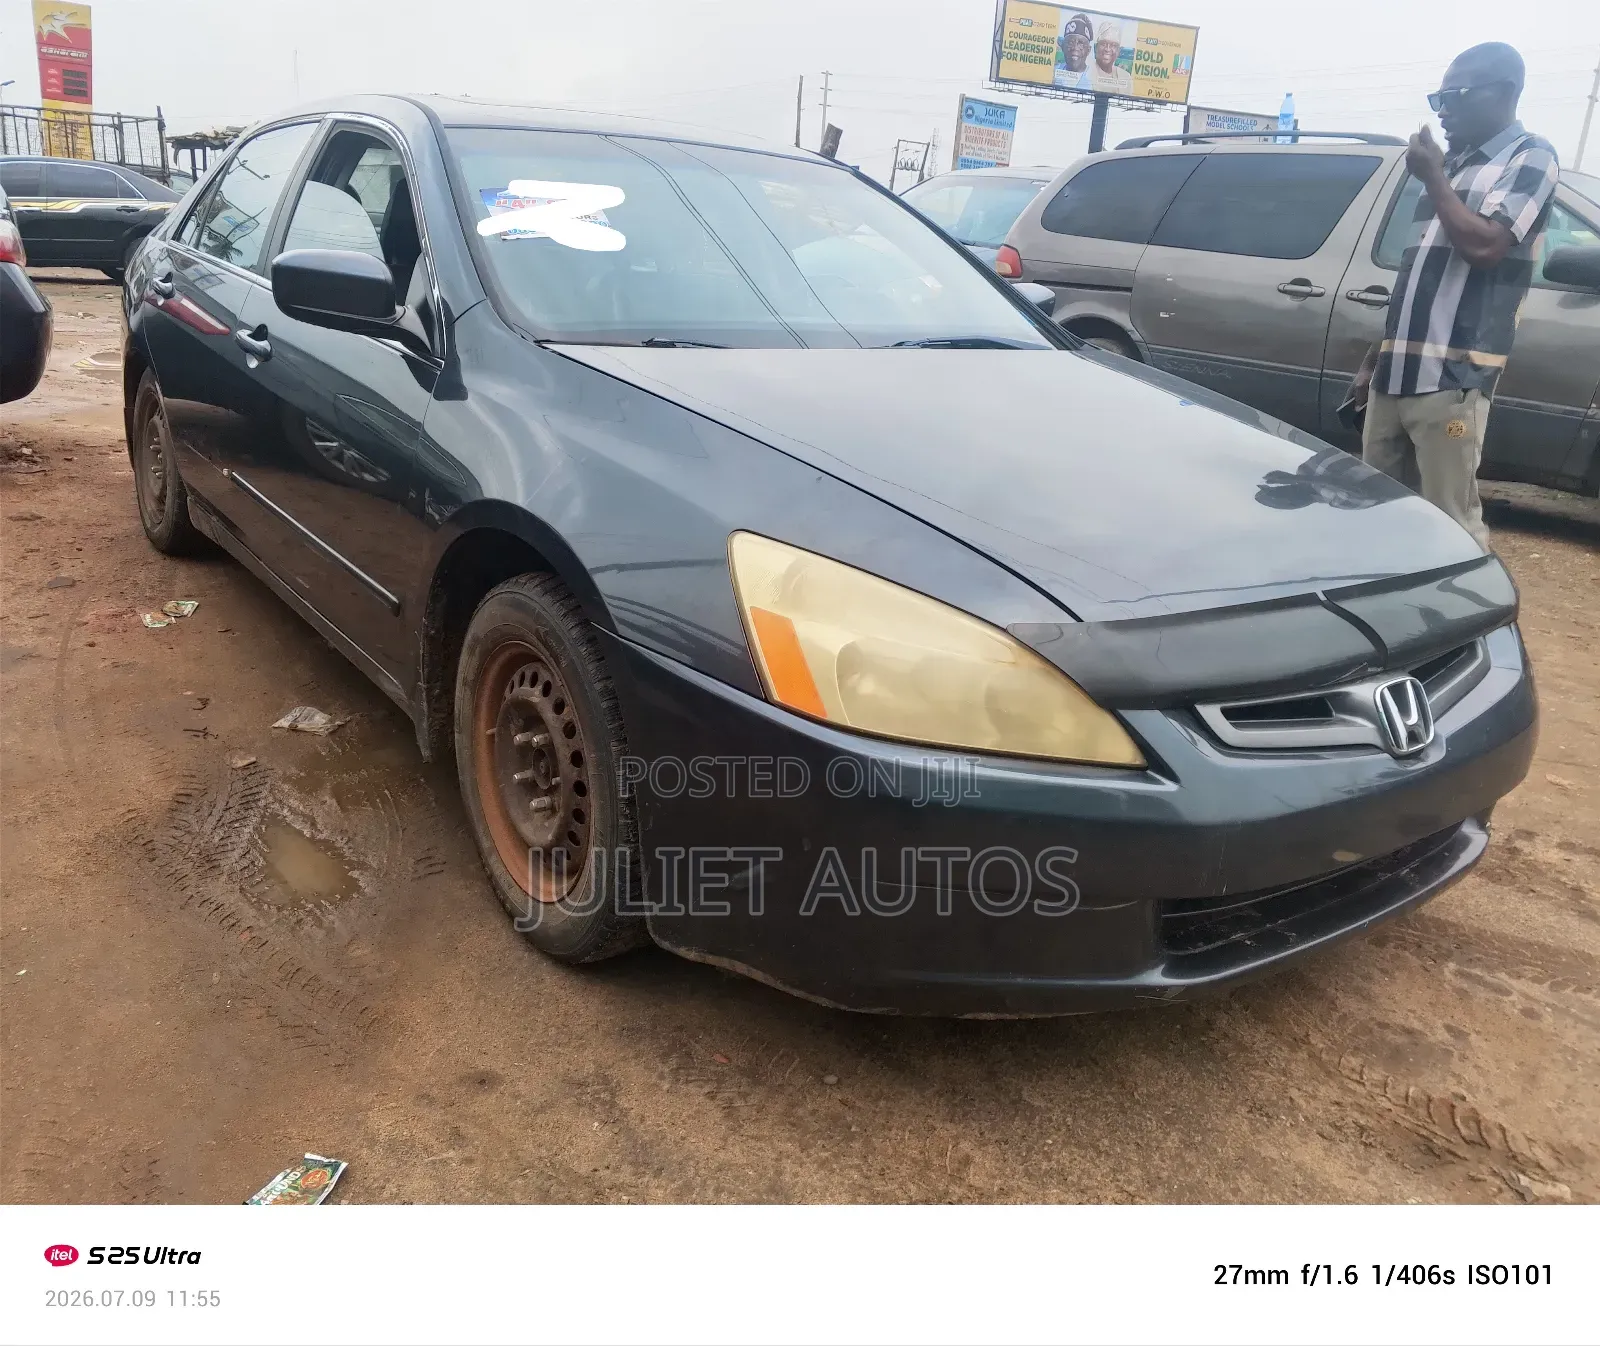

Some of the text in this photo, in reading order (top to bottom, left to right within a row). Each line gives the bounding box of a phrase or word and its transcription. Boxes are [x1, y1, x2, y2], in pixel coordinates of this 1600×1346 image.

[1009, 31, 1055, 45] COURAGEOUS
[1004, 40, 1054, 55] LEADERSHIP
[1002, 51, 1052, 66] FOR NIGERIA
[1135, 49, 1163, 63] BOLD
[1134, 63, 1170, 79] VISION.
[985, 108, 1006, 119] JUKA
[1206, 114, 1258, 127] TREASUREFILLED
[1206, 120, 1254, 131] MODEL SCHOOLS
